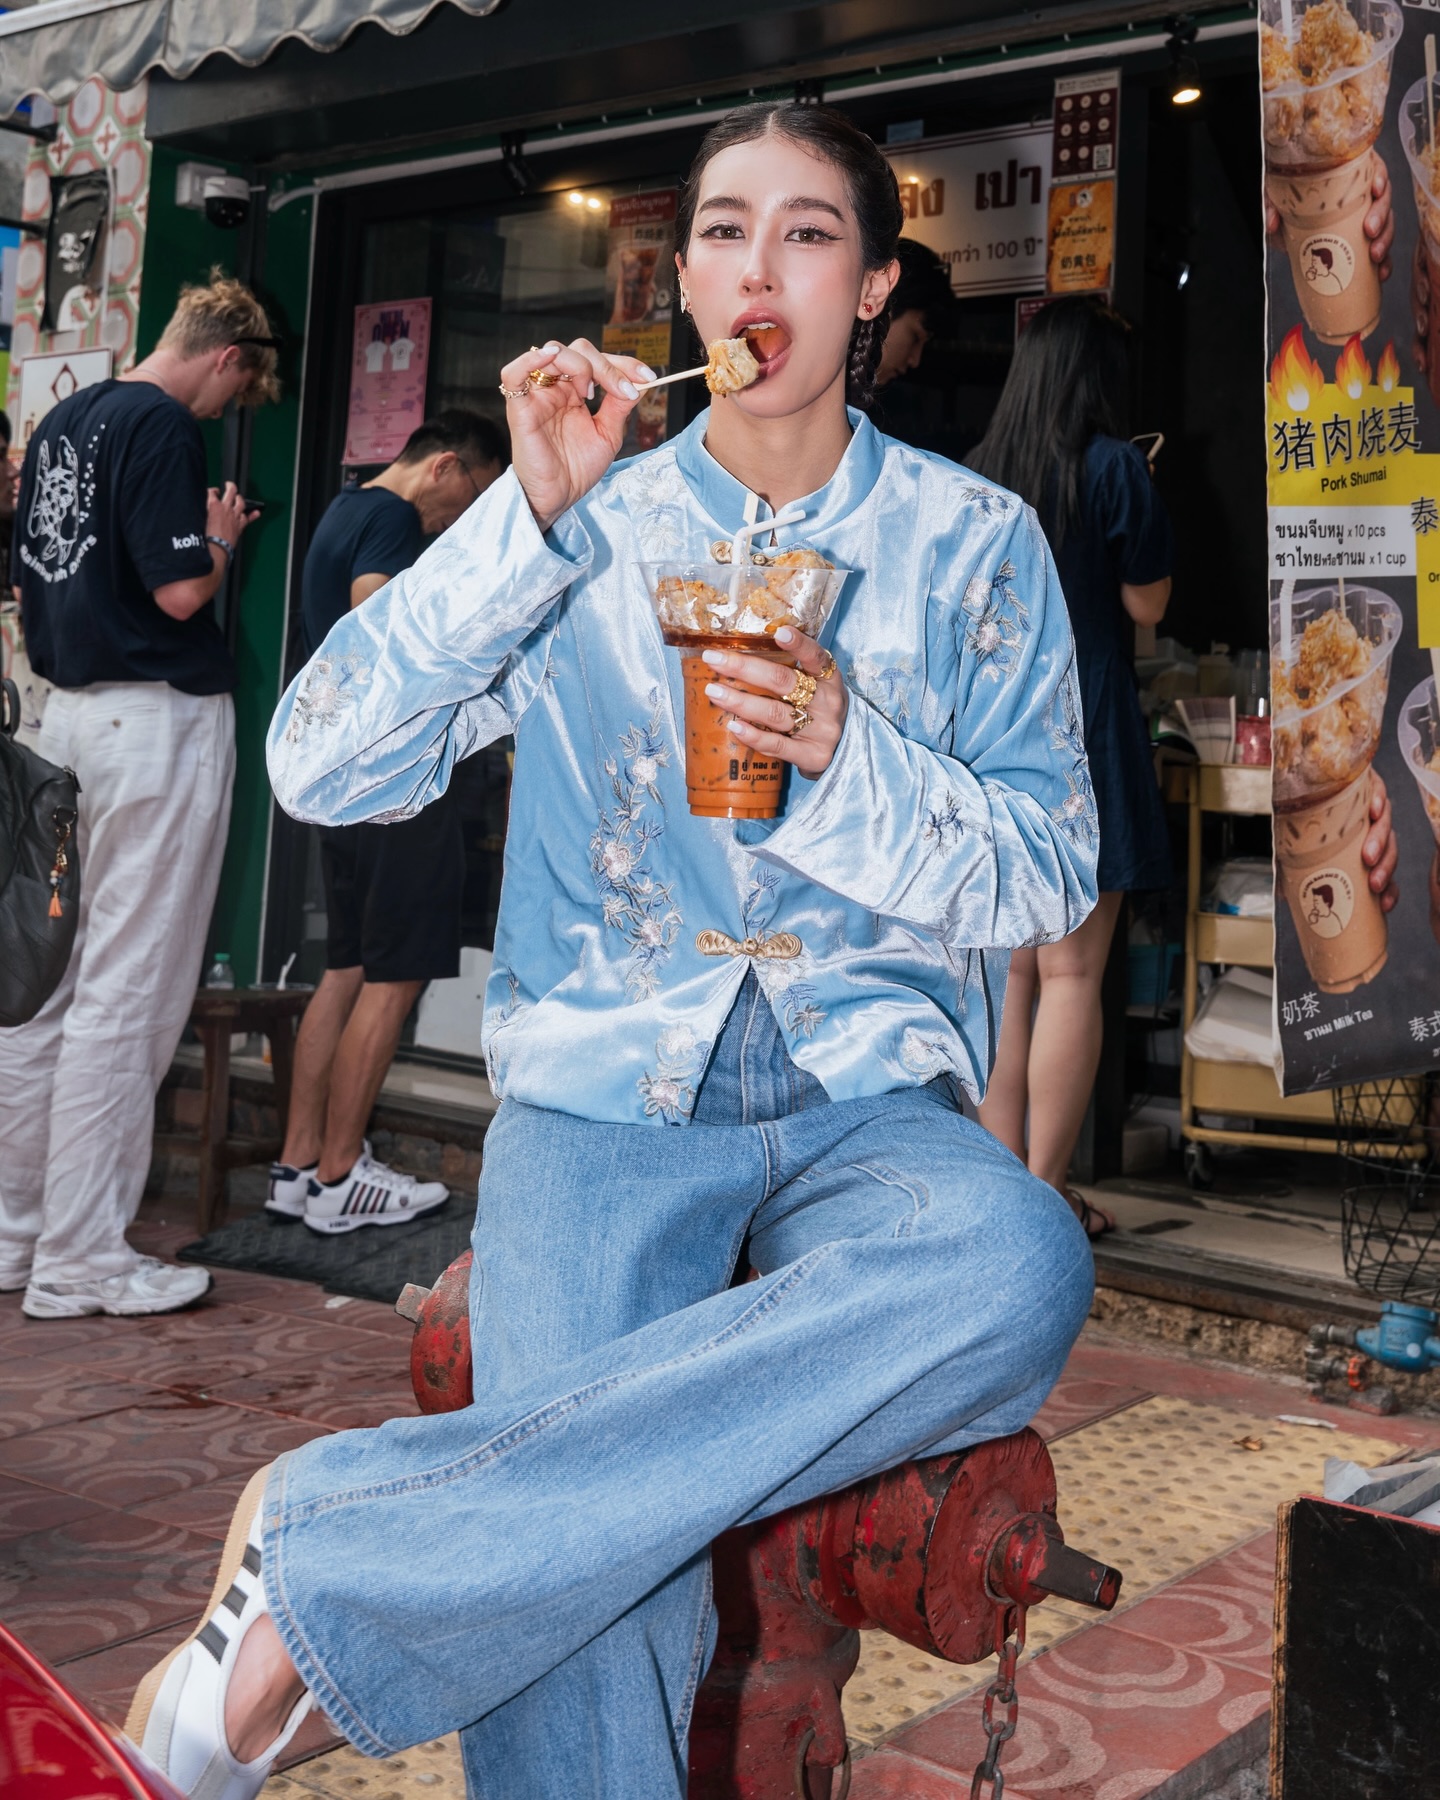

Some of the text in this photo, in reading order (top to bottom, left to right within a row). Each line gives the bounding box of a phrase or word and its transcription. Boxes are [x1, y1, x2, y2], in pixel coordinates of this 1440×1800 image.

[974, 159, 1042, 211] เปา
[986, 240, 1019, 260] 100
[1272, 400, 1422, 473] 猪肉烧麦
[1320, 466, 1387, 493] Pork Shumai
[171, 532, 200, 551] koh
[1275, 518, 1344, 545] ขนมจีบหมู
[1367, 525, 1386, 541] pcs
[1386, 553, 1407, 568] cup
[1280, 991, 1322, 1026] 奶茶
[1334, 1014, 1355, 1032] Milk
[1355, 1009, 1374, 1023] Tea
